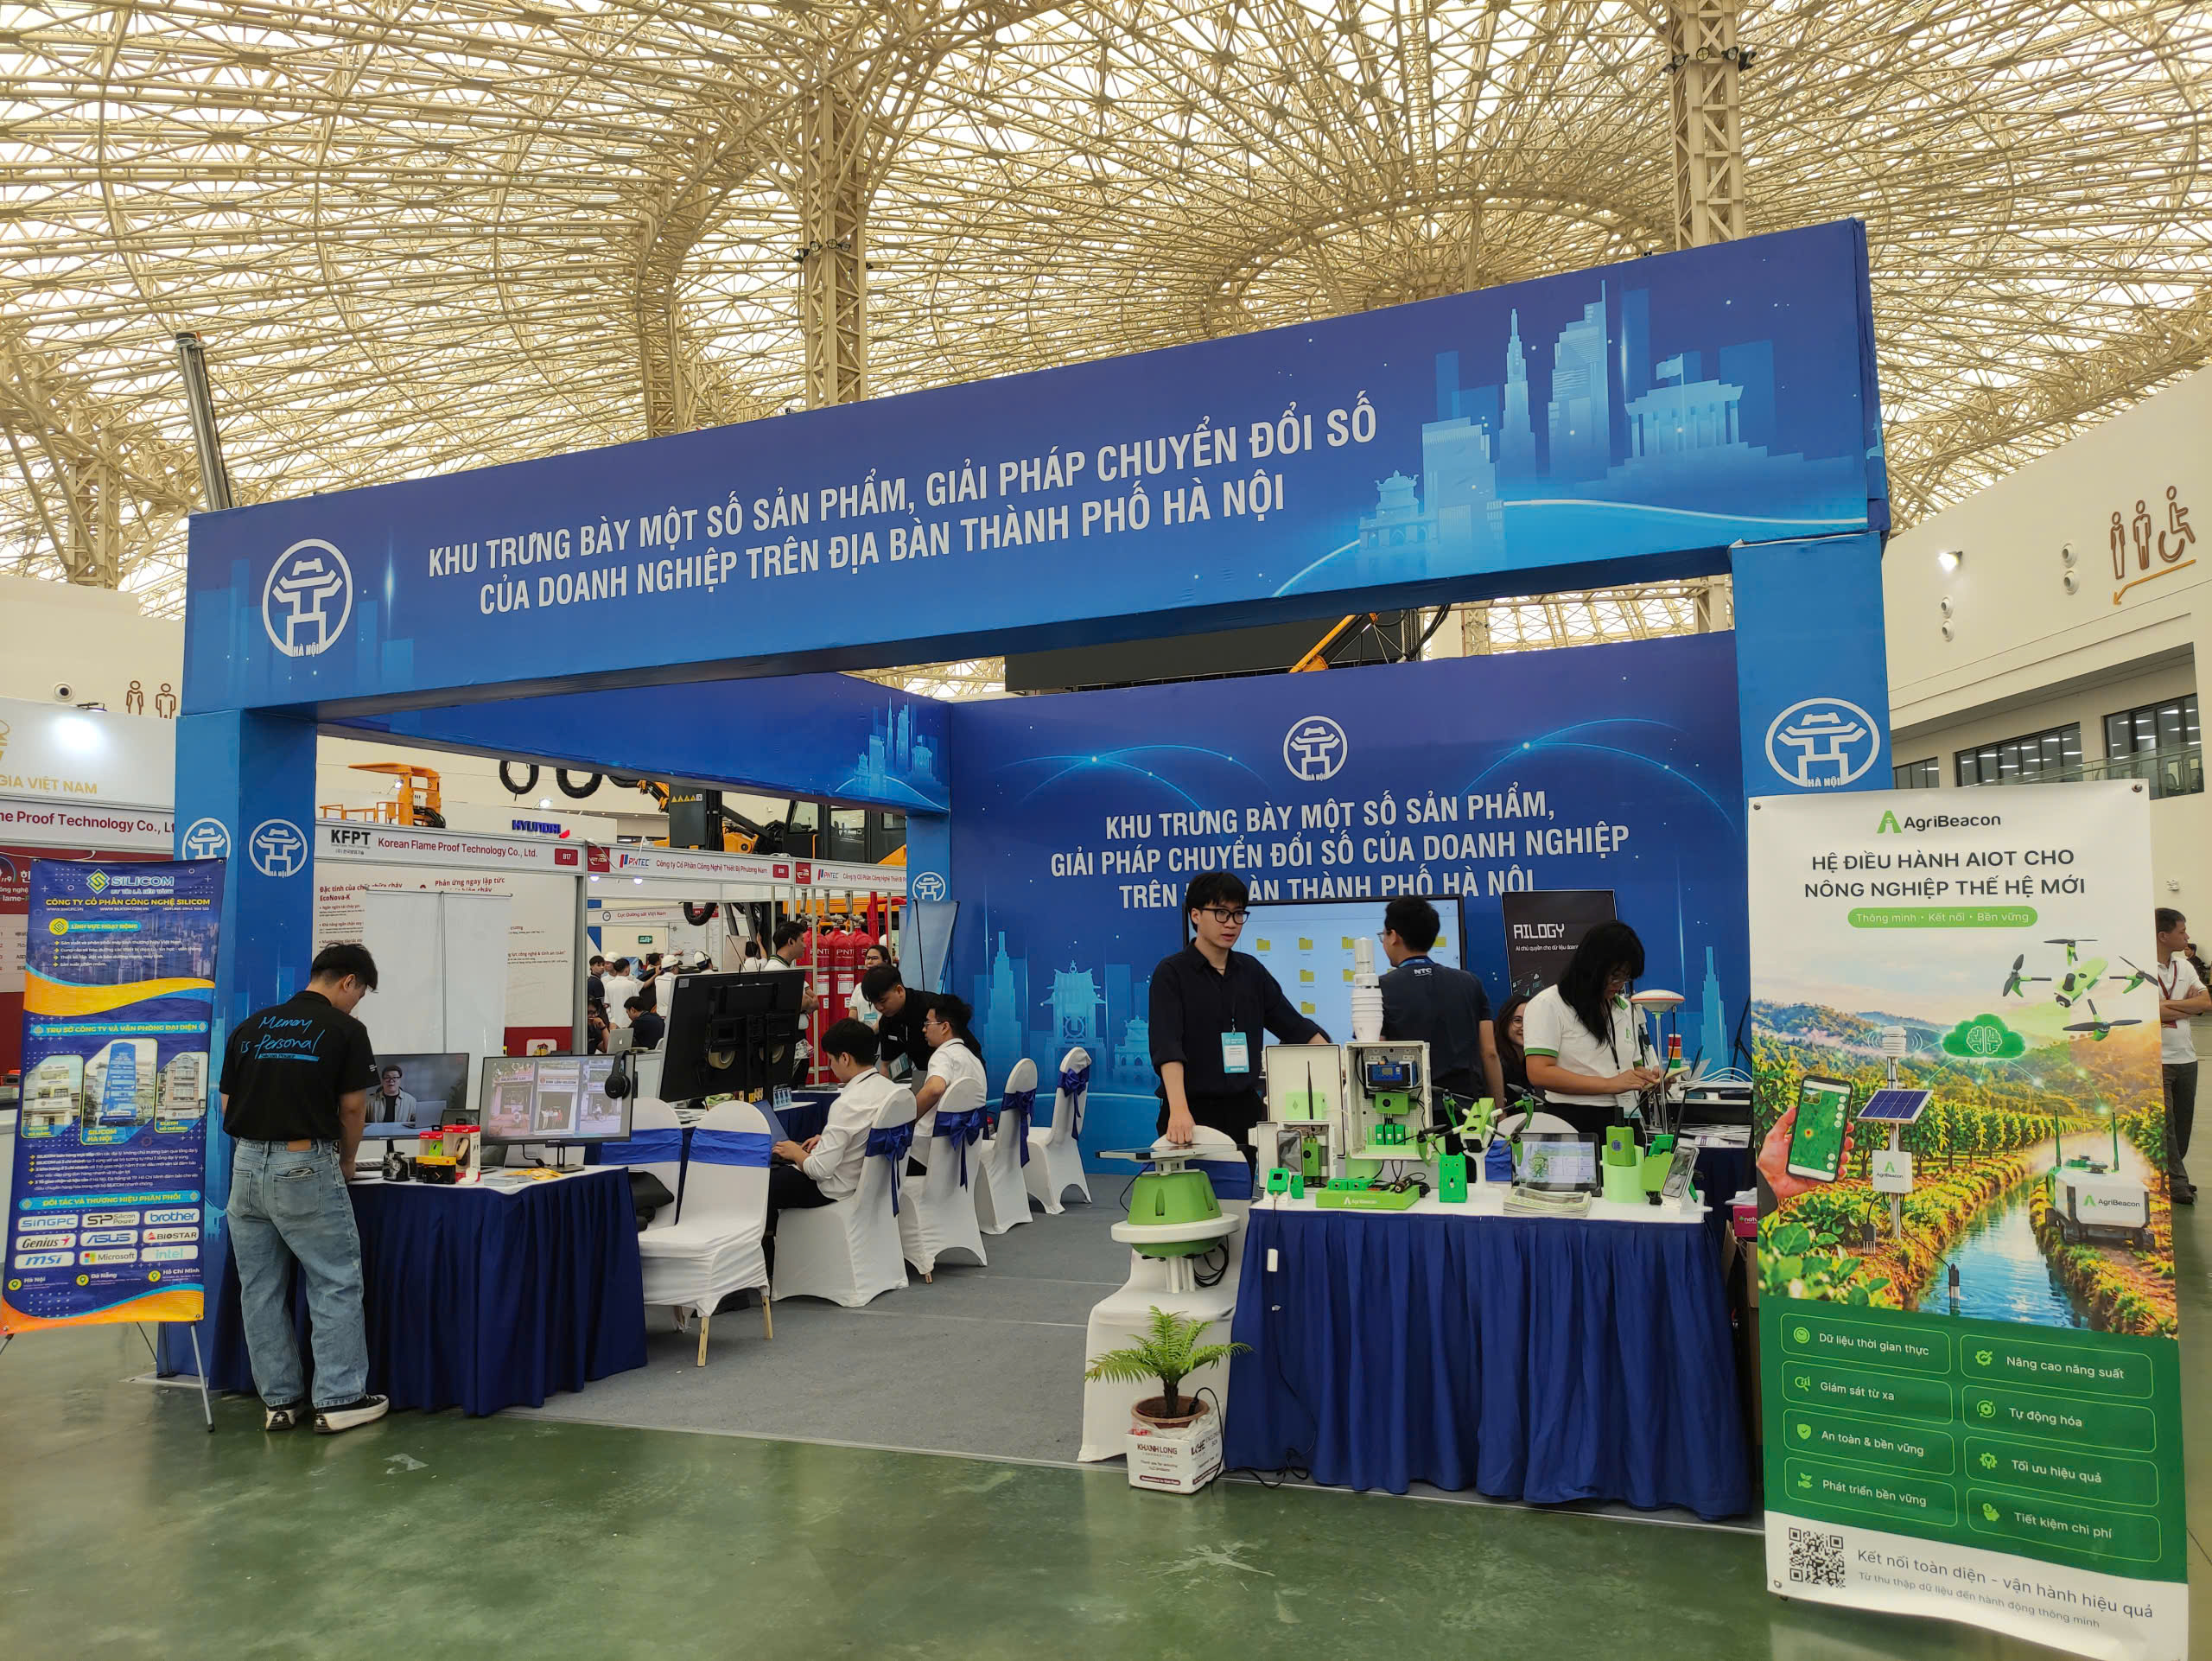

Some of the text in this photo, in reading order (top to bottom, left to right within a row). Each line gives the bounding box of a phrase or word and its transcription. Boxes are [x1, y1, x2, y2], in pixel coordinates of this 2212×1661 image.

[429, 390, 1376, 576] KHU TRƯNG BÀY MỘT SỐ SẢN PHẨM, GIẢI PHÁP CHUYỂN ĐỔI SỐ
[480, 469, 1285, 614] CỦA DOANH NGHIỆP TRÊN ĐỊA BÀN THÀNH PHỐ HÀ NỘI
[28, 776, 59, 792] VIỆT
[62, 781, 98, 794] NAM
[1106, 781, 1555, 840] KHU TRƯNG BÀY MỘT SỐ SẢN PHẨM,
[16, 811, 54, 824] Proof
[58, 813, 134, 832] Technology
[137, 820, 161, 835] Co.,
[512, 819, 560, 834] HYUNDAI
[1904, 813, 2001, 831] AgriBeacon
[331, 830, 371, 845] KFPT
[378, 837, 410, 850] Korean
[411, 840, 436, 851] Flame
[438, 842, 460, 852] Proof
[462, 844, 505, 857] Technology
[507, 847, 523, 858] Co.,
[524, 849, 538, 857] Ltd.
[1051, 821, 1630, 877] GIẢI PHÁP CHUYỂN ĐỔI SỐ CỦA DOANH NGHIỆP
[629, 858, 650, 867] PNTEC
[1812, 849, 2075, 873] HỆ ĐIỀU HÀNH AIOT CHO
[111, 876, 174, 887] SILICOM
[1119, 880, 1177, 908] TRÊN
[1249, 875, 1280, 901] ÀN
[1287, 869, 1371, 900] THÀNH
[1382, 863, 1433, 897] PHỐ
[1443, 866, 1479, 897] HÀ
[1805, 875, 2086, 900] NÔNG NGHIỆP THẾ HỆ MỚI
[85, 897, 98, 906] CỔ
[99, 897, 124, 906] PHẦN
[124, 897, 149, 906] CÔNG
[151, 898, 175, 907] NGHỆ
[1856, 910, 2029, 926] Thông minh Kết nối Bền vững
[1513, 923, 1565, 939] AILOGY
[258, 1016, 313, 1033] Memory
[255, 1029, 325, 1059] Personal
[2099, 1198, 2140, 1207] AgriBeacon
[87, 1215, 112, 1225] SP
[150, 1212, 194, 1222] brother
[22, 1238, 58, 1249] Genius
[86, 1233, 131, 1244] ASUS
[157, 1231, 197, 1240] BIOSTAR
[98, 1252, 134, 1261] Microsoft
[156, 1248, 183, 1259] intel
[1820, 1333, 1929, 1357] Dữ liệu thời gian thực
[2006, 1356, 2125, 1378] Nâng cao năng suất
[1821, 1382, 1895, 1401] Giám sát từ xa
[2009, 1408, 2082, 1427] Tự động hóa
[1821, 1431, 1924, 1457] An toàn & bền vững
[2012, 1460, 2101, 1484] Tối ưu hiệu quả
[1823, 1480, 1926, 1507] Phát triển bền vững
[2014, 1512, 2112, 1539] Tiết kiệm chi phí
[1858, 1550, 2152, 1618] Kết nối toàn diện vận hành hiệu quả
[1859, 1572, 2100, 1628] Từ thu thập dữ liệu đến hành động thông minh
